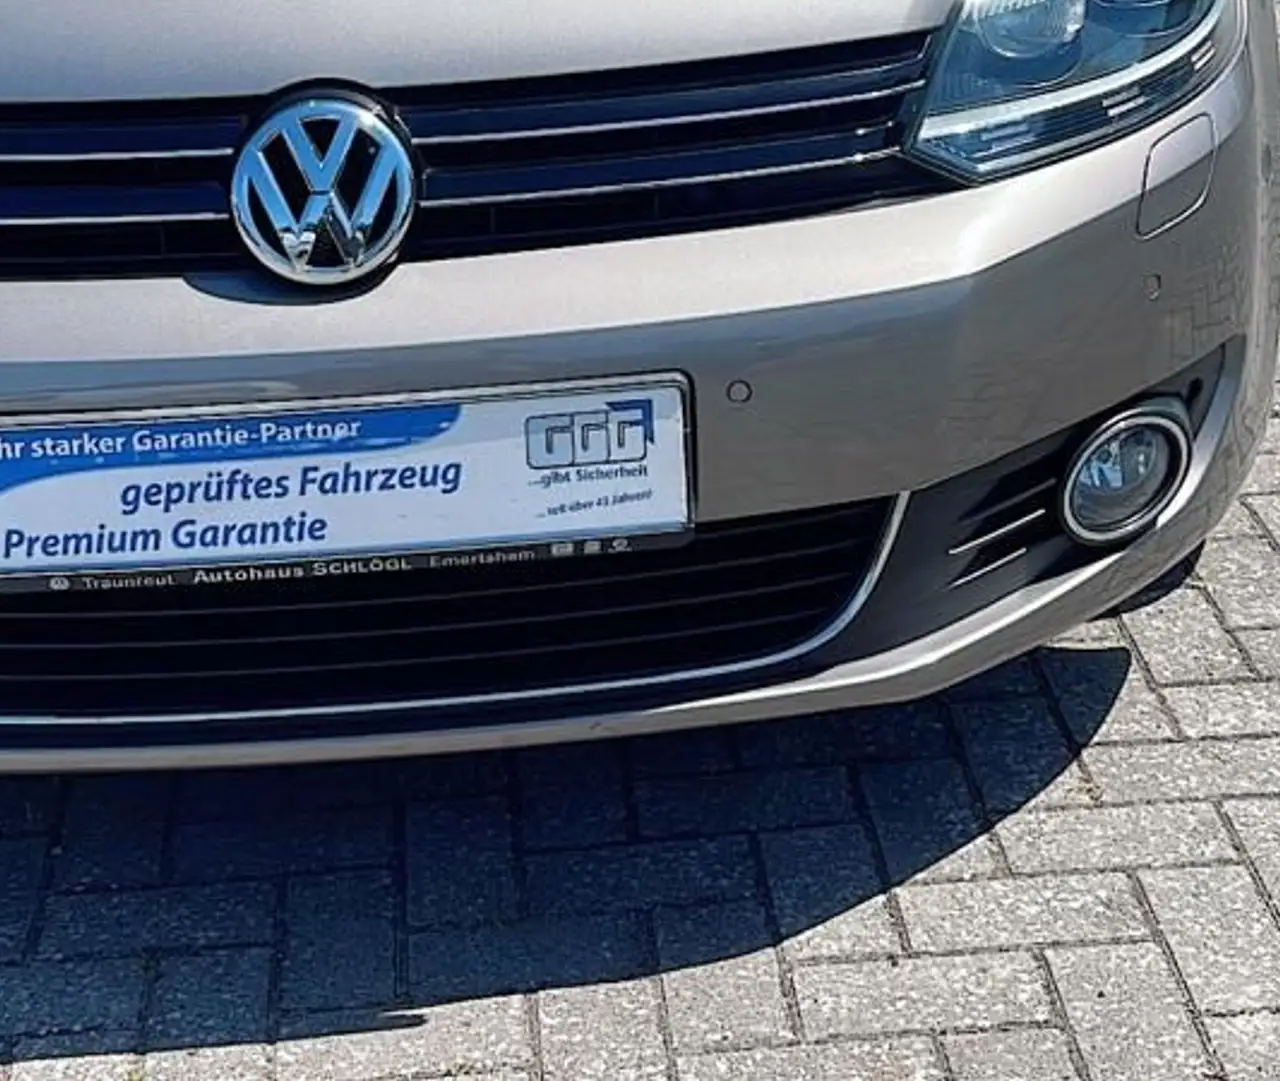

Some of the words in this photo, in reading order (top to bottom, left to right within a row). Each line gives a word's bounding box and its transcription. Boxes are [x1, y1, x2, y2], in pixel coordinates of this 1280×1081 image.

[31, 433, 126, 458] starker
[132, 421, 361, 452] Garantie-Partner
[121, 469, 290, 516] geprüftes
[298, 461, 463, 496] Fahrzeug
[576, 464, 648, 482] Sicherheit
[3, 523, 161, 559] Premium
[172, 511, 328, 549] Garantie
[82, 574, 176, 590] Traunreut
[193, 565, 304, 584] Autohaus
